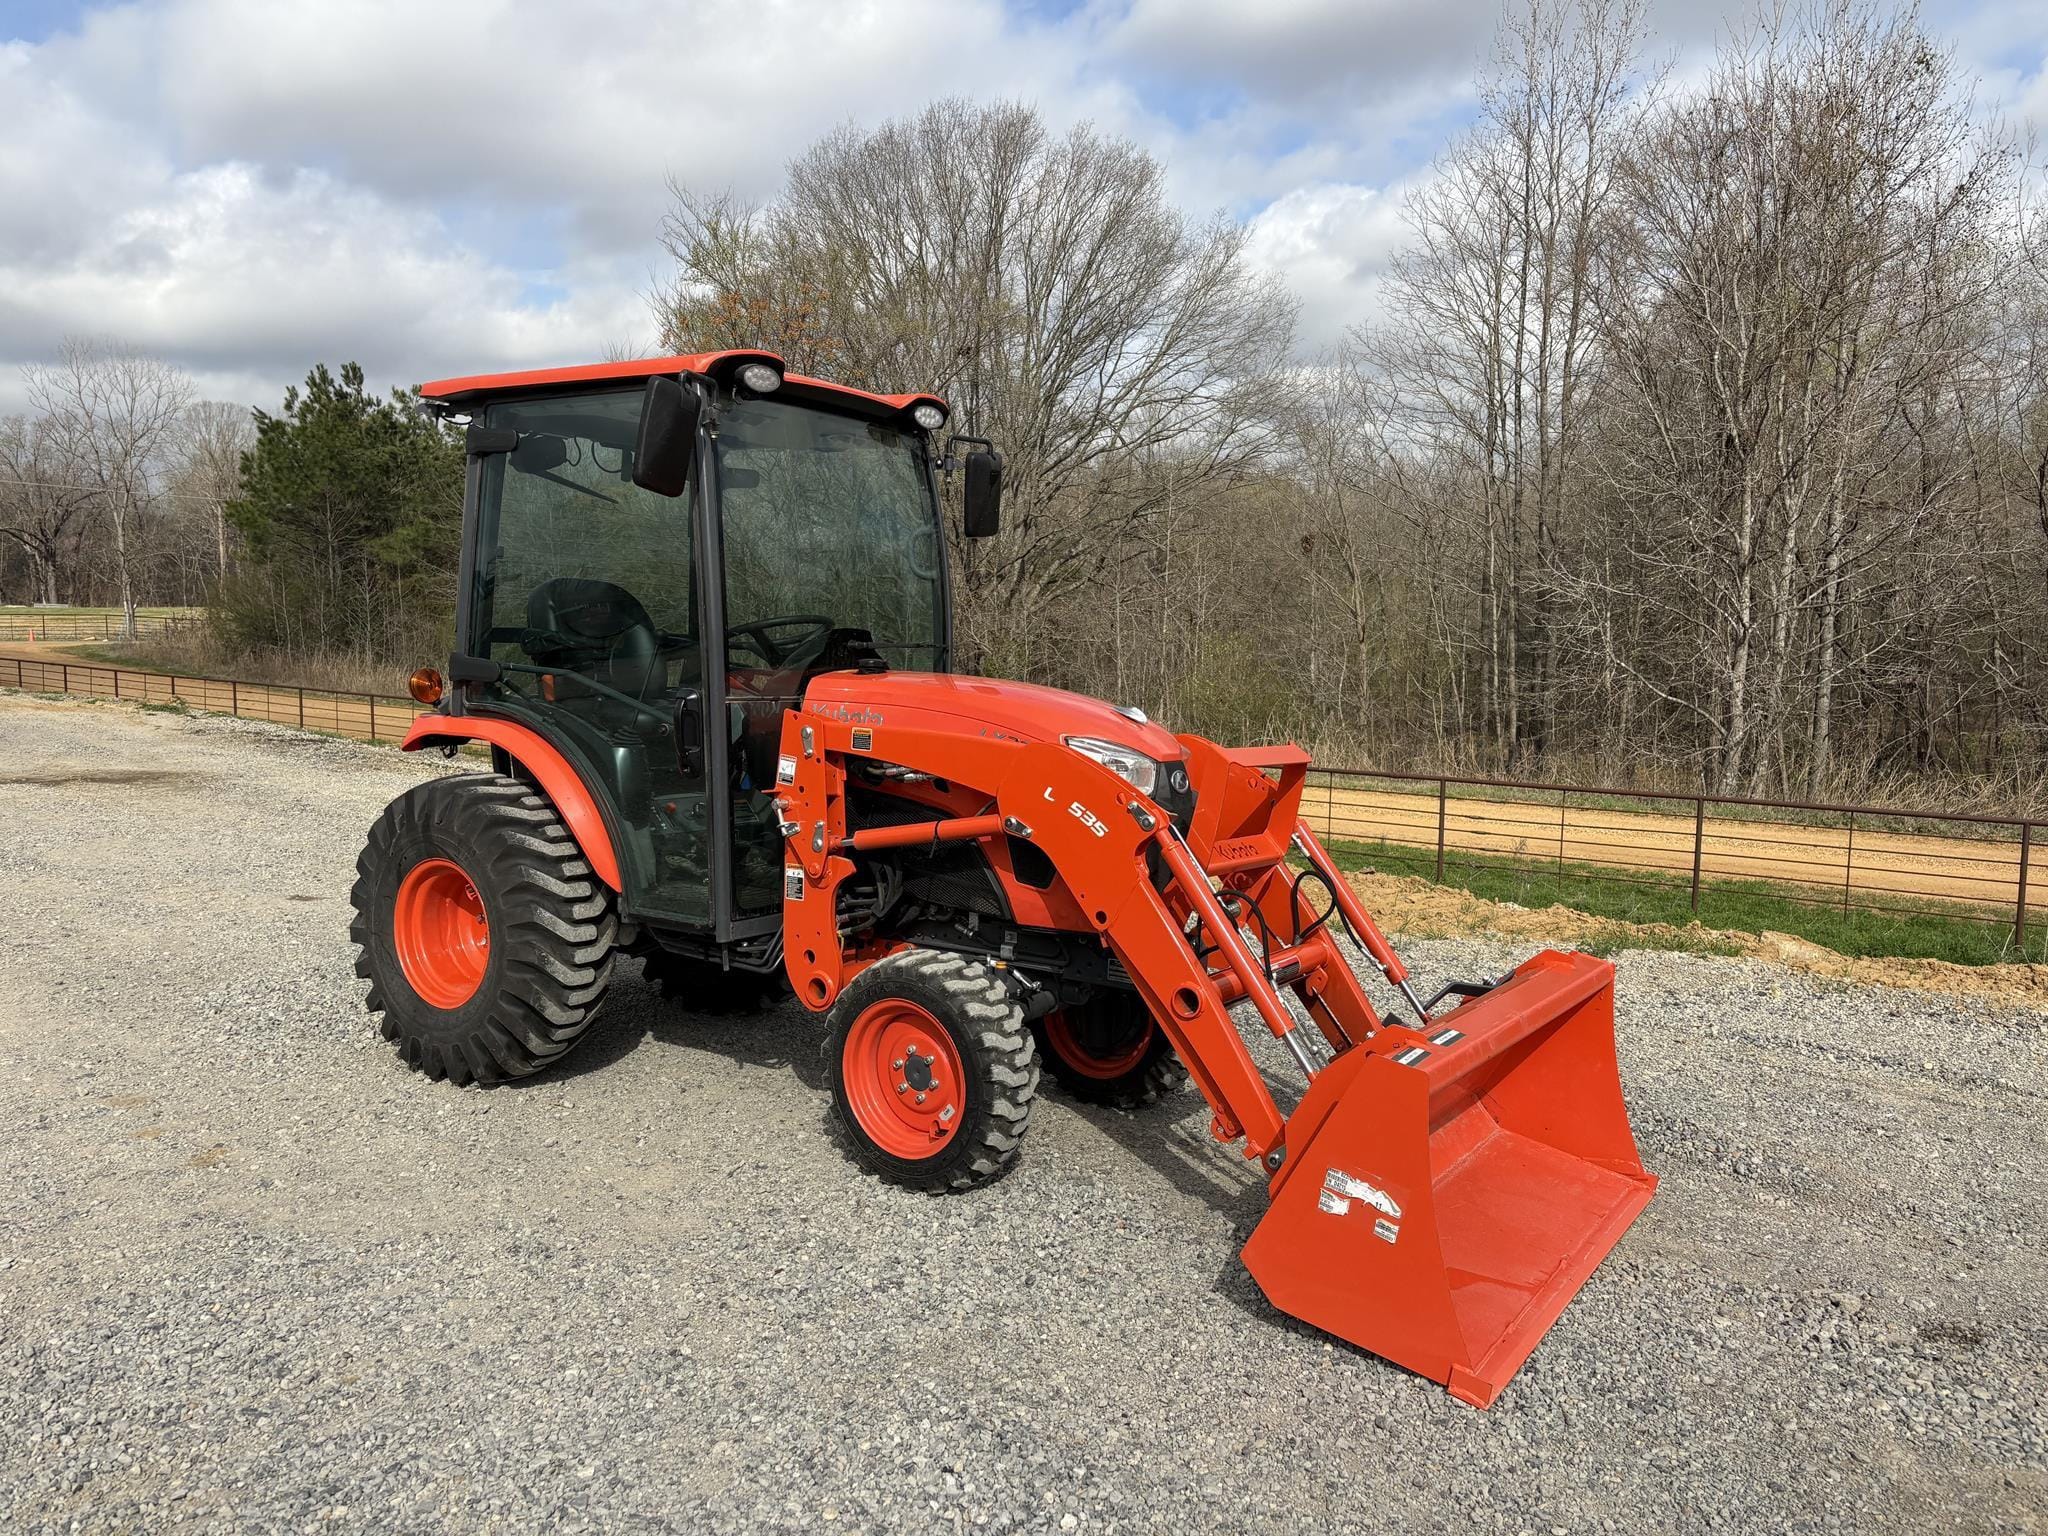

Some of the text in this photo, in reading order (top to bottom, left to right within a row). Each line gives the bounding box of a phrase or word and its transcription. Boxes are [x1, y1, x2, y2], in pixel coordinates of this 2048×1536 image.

[812, 703, 884, 726] Kubota
[1044, 786, 1109, 837] L 535
[1213, 842, 1259, 861] Kubota
